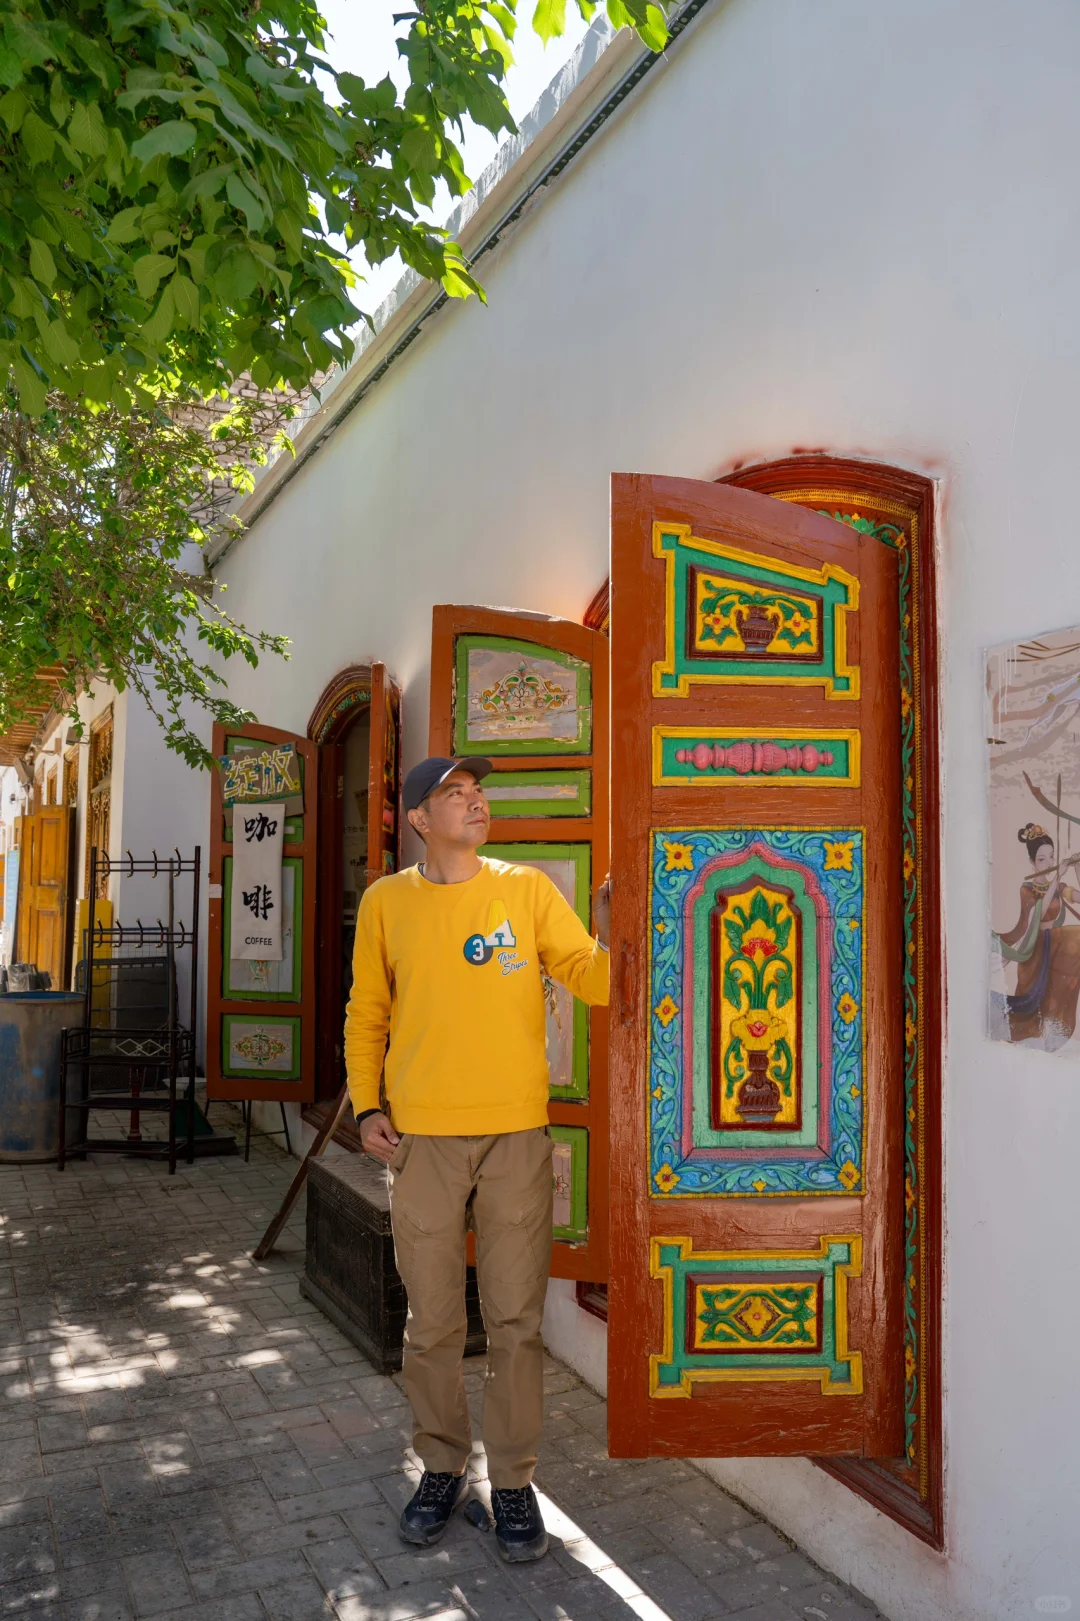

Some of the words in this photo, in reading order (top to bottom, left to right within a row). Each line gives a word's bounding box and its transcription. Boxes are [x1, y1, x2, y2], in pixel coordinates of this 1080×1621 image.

[224, 749, 293, 799] 绽放
[242, 812, 278, 921] 咖啡
[244, 936, 273, 946] COFFEE
[472, 938, 485, 961] 3
[497, 951, 517, 964] Three
[501, 959, 528, 976] Stripes
